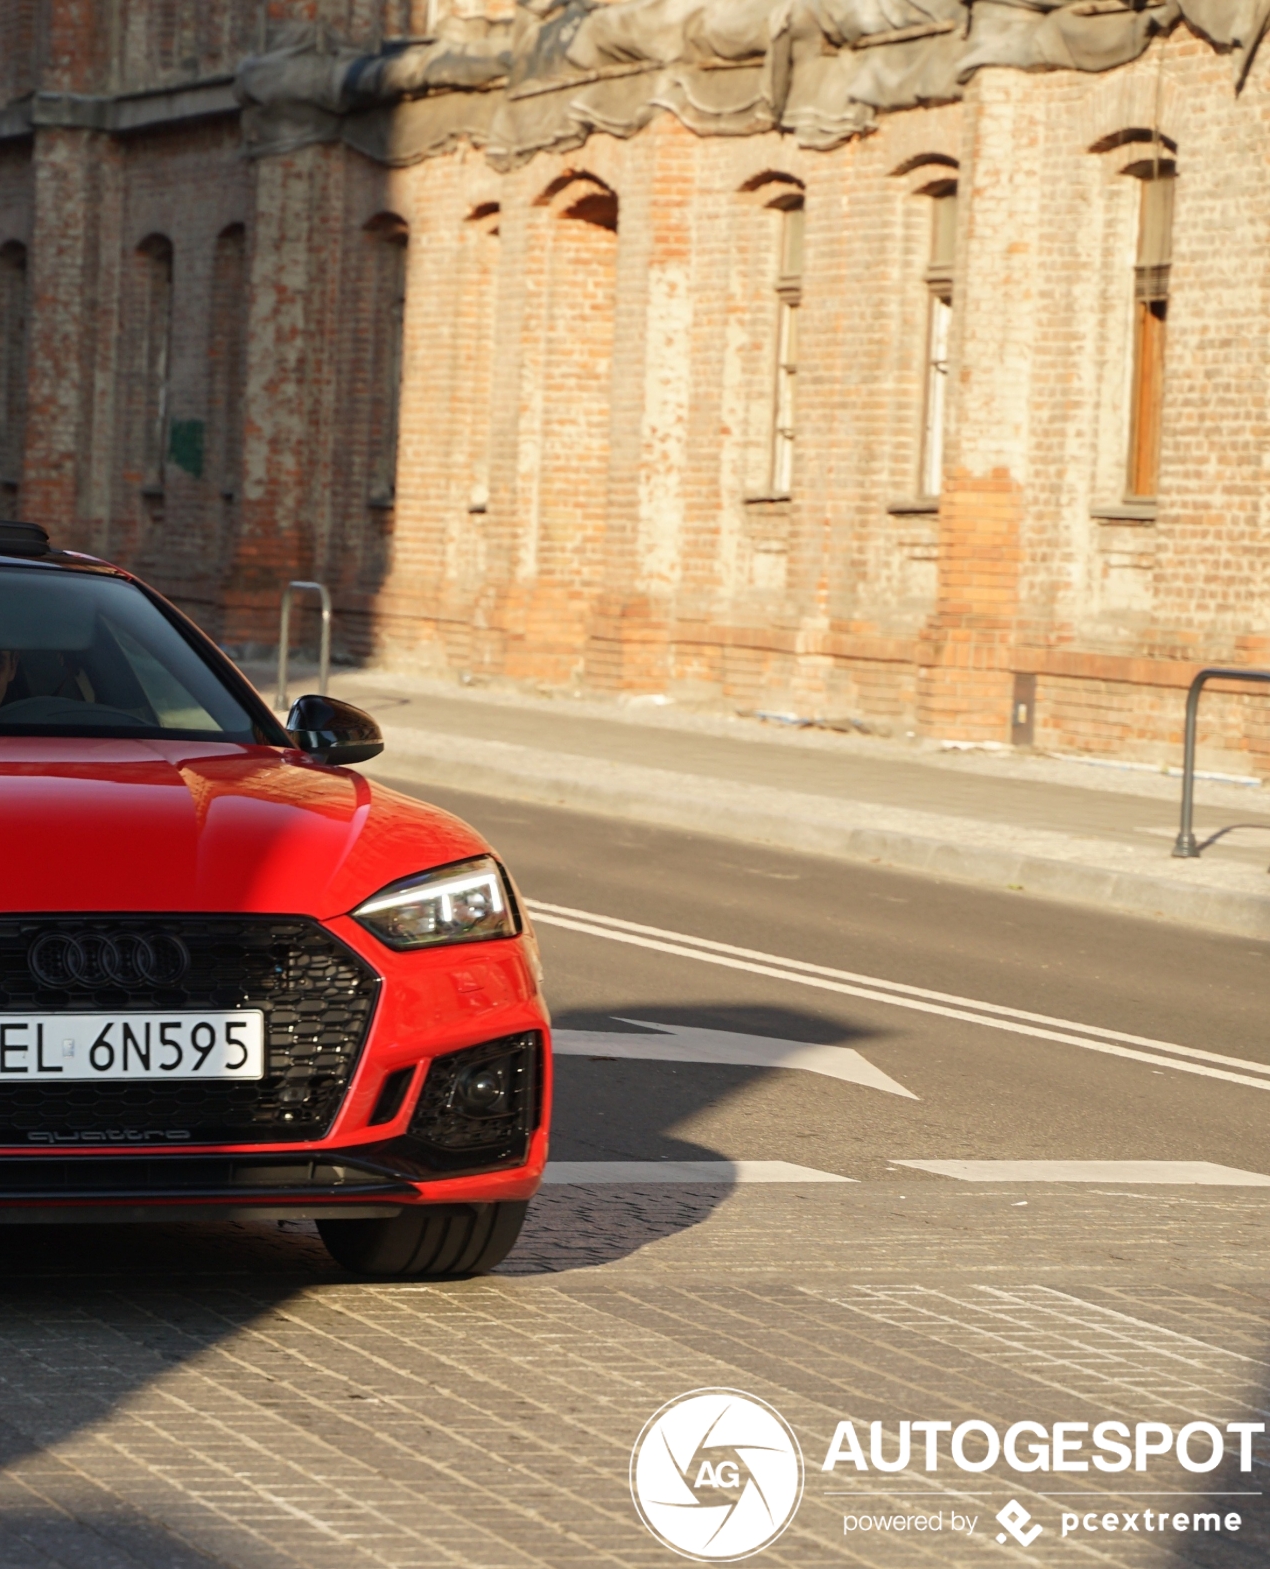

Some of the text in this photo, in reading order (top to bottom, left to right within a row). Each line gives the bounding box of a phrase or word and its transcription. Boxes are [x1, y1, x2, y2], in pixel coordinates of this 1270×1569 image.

[0, 1022, 248, 1073] EL 6N595
[27, 1129, 191, 1143] quattro
